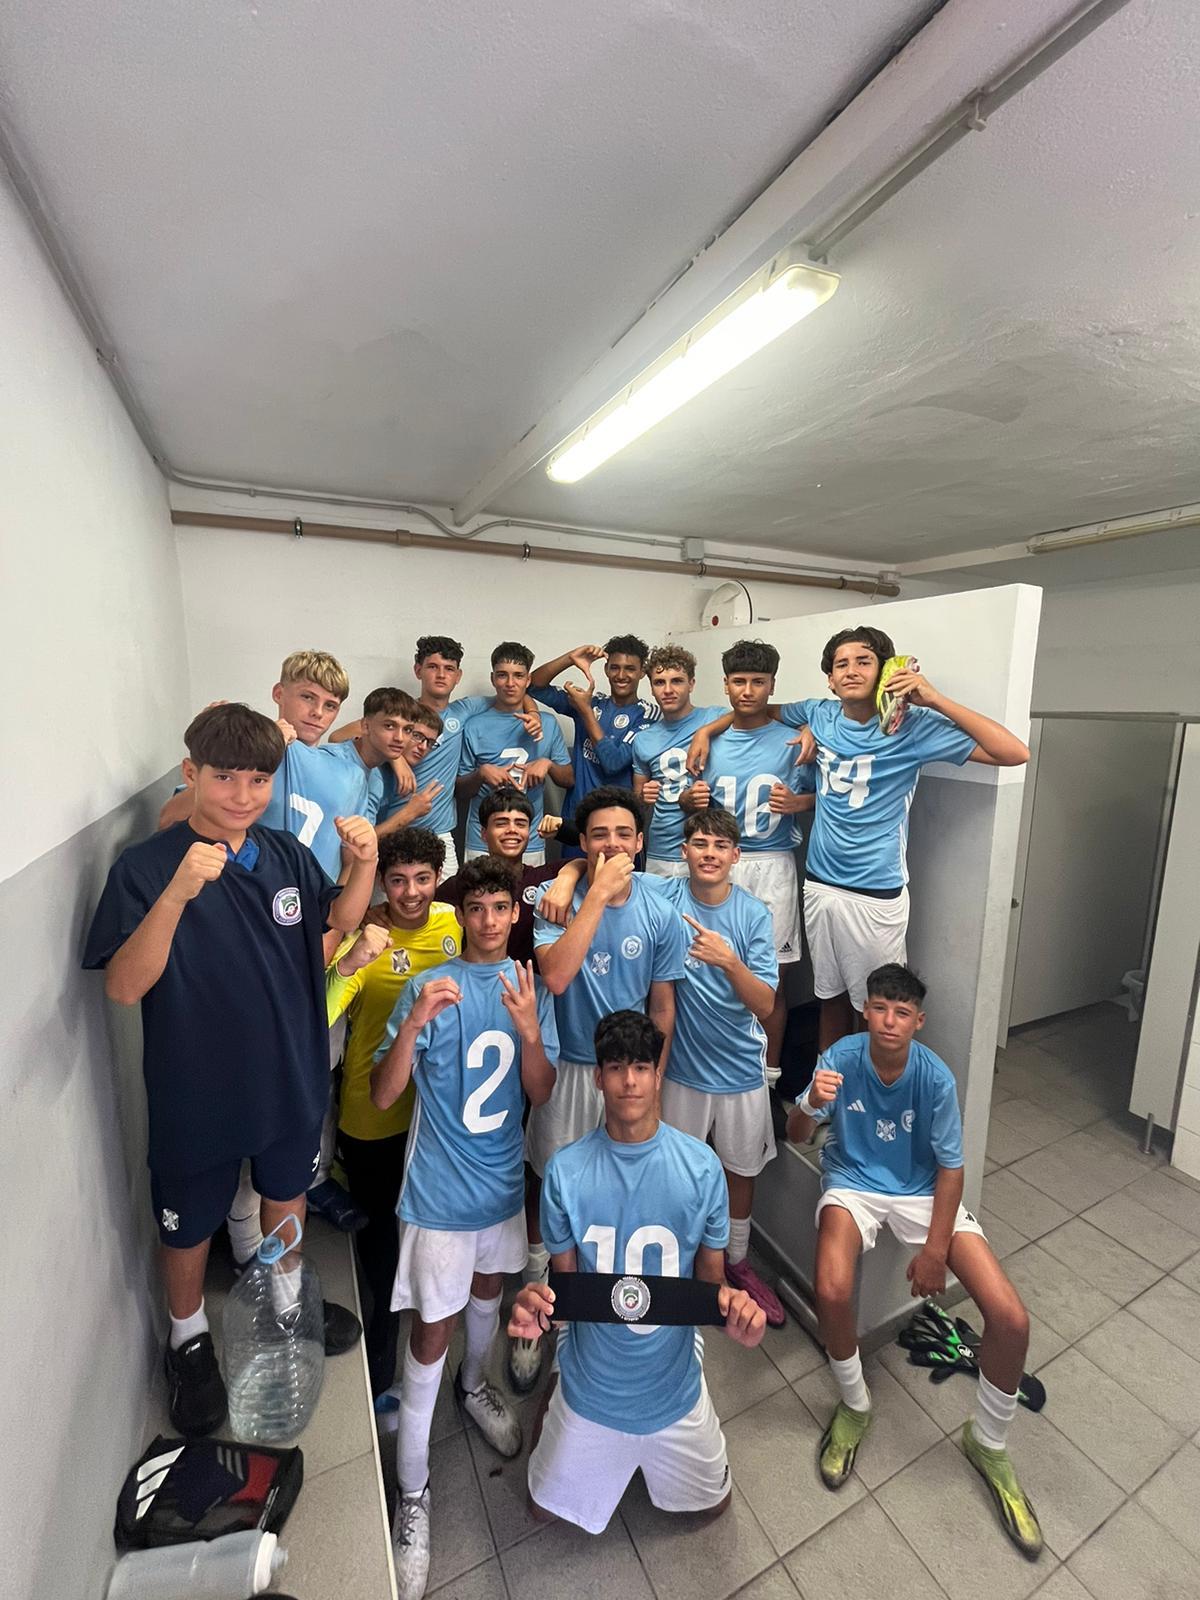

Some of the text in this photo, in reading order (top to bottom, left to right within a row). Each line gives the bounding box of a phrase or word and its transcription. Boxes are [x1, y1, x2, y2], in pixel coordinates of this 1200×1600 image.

[660, 747, 688, 802] 8
[716, 773, 783, 839] 16
[817, 746, 876, 808] 14
[289, 792, 324, 848] 7
[462, 1030, 516, 1134] 2
[582, 1225, 679, 1335] 10
